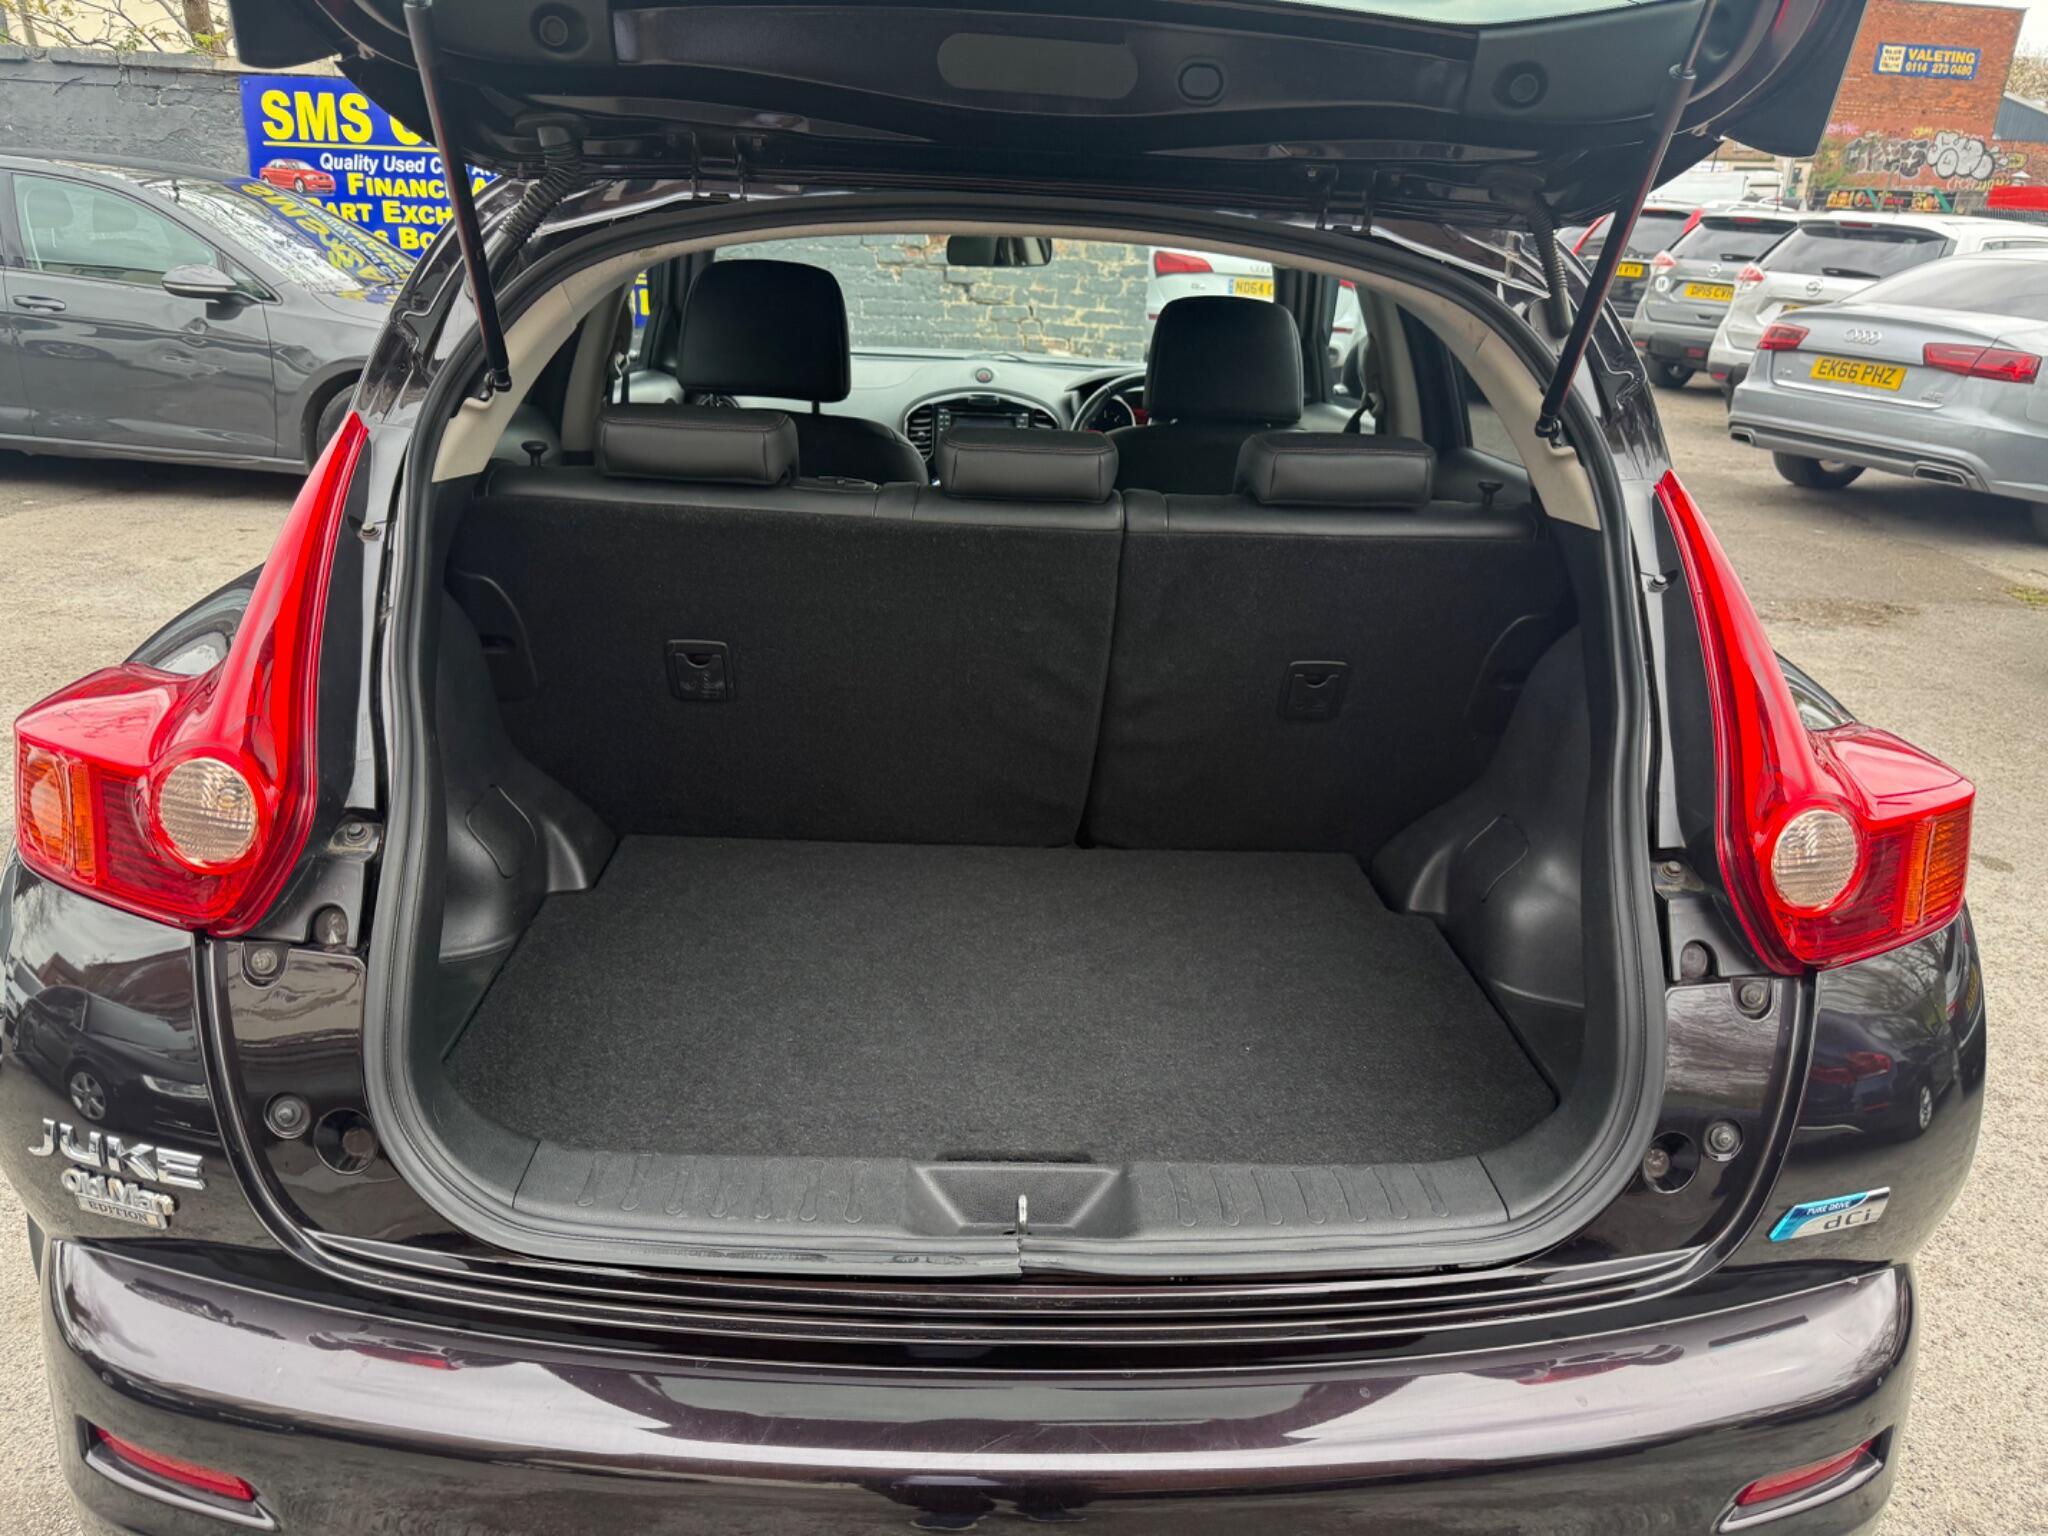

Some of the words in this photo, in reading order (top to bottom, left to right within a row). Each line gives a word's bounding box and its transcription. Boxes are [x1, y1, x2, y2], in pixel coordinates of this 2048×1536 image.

[1908, 48, 1976, 65] VALETING
[260, 89, 373, 143] SMS
[319, 152, 379, 176] Quality
[383, 154, 426, 174] Used
[346, 172, 450, 199] FINANC
[381, 199, 454, 226] EXCH
[1817, 357, 1860, 380] EK66
[1860, 364, 1897, 385] PHZ
[28, 1118, 206, 1190] JUKE
[1823, 1208, 1872, 1230] dCi
